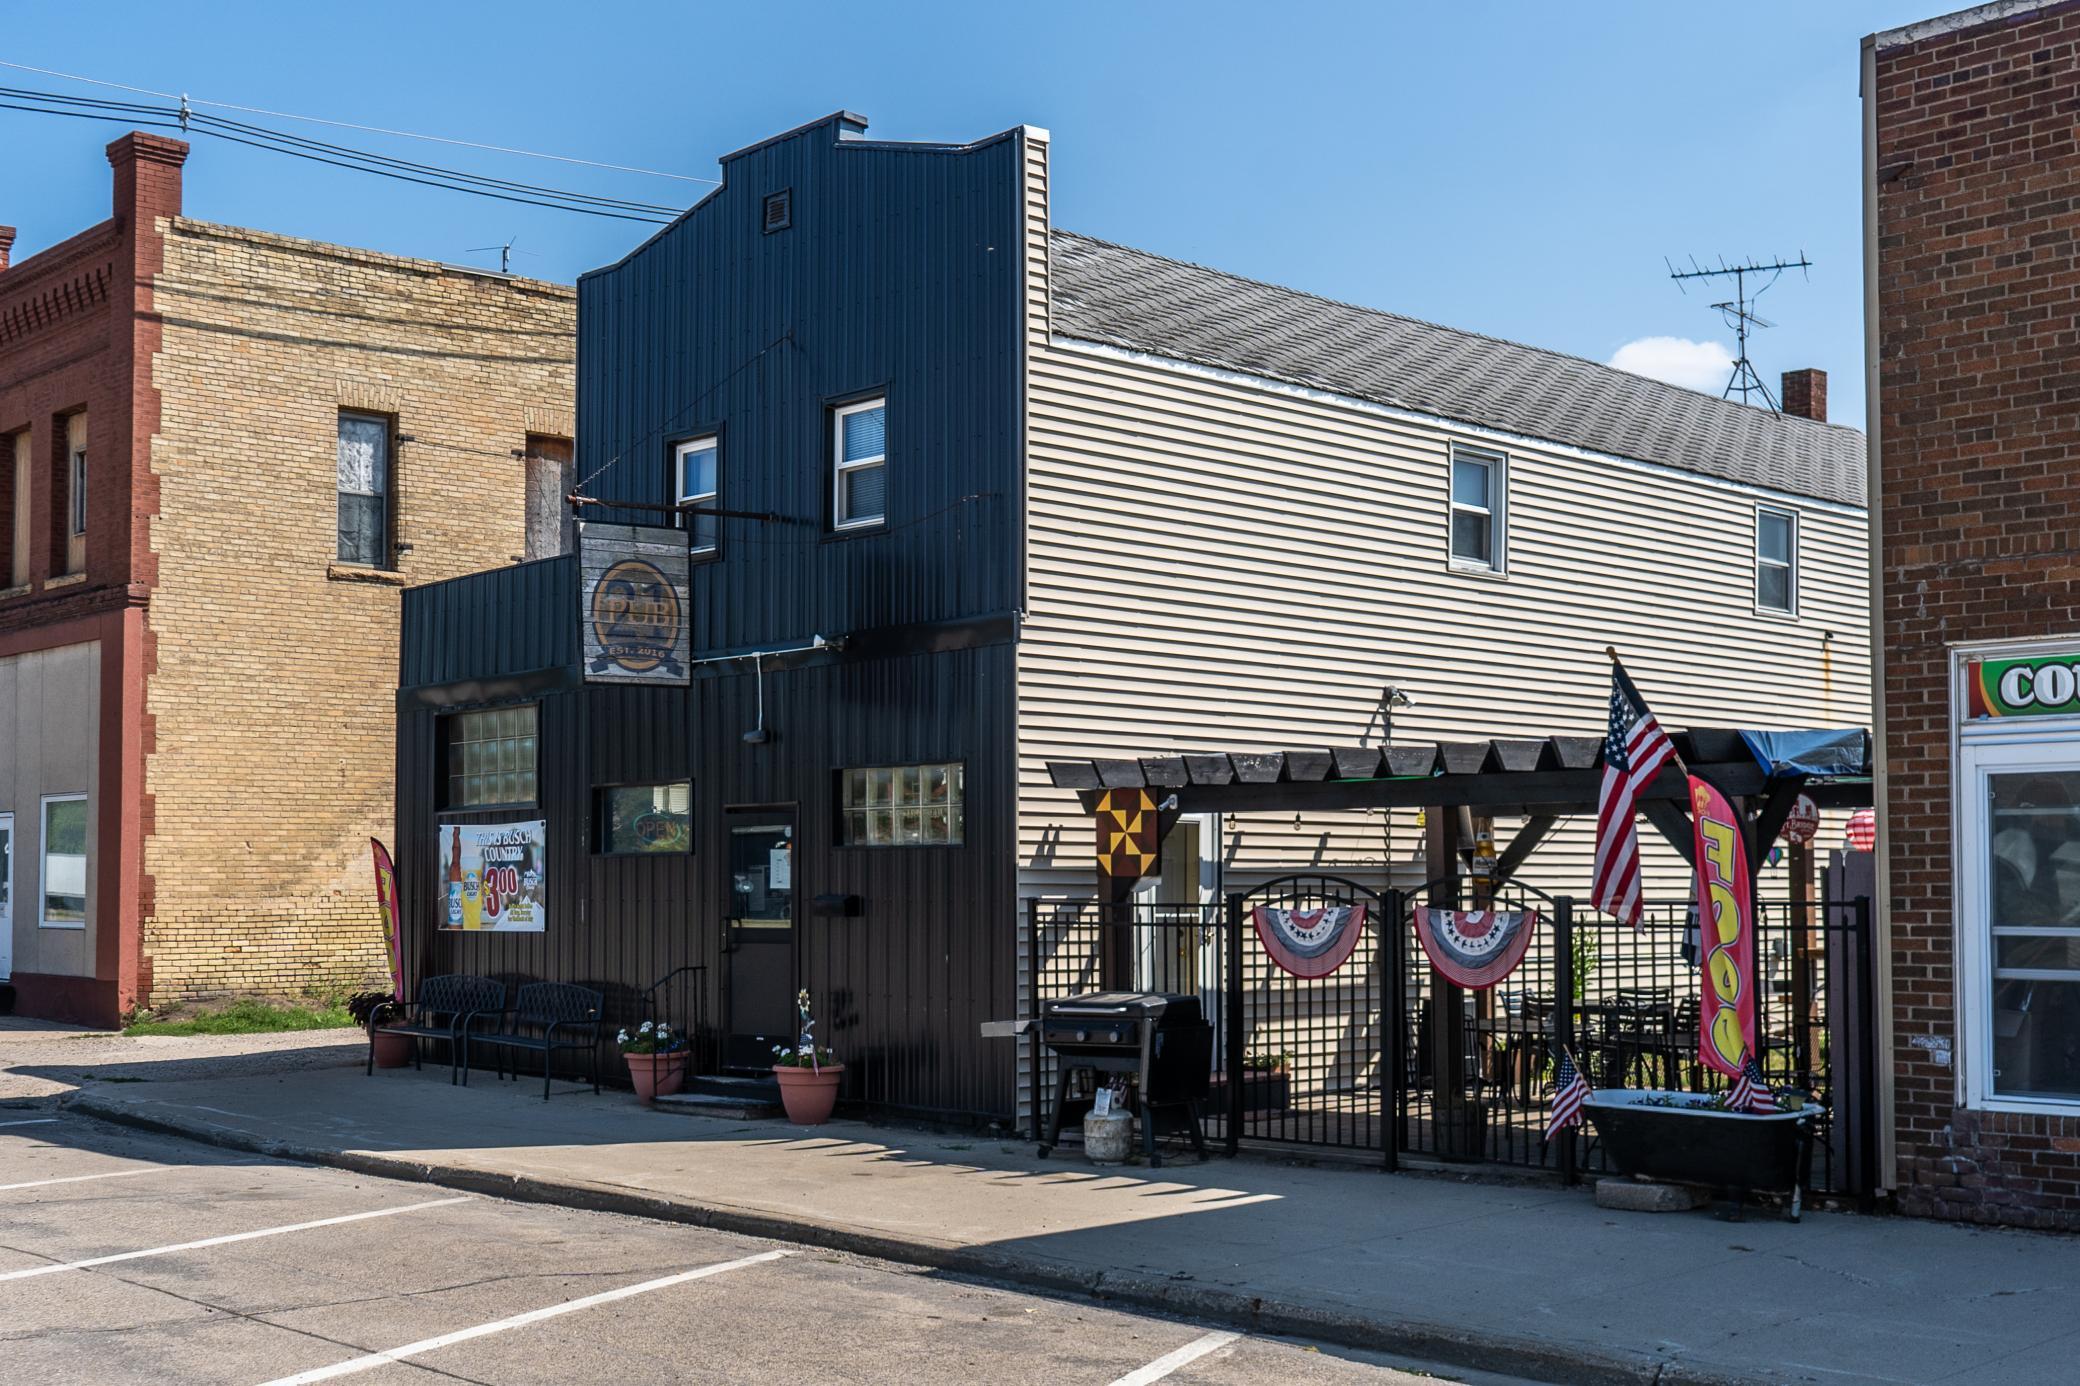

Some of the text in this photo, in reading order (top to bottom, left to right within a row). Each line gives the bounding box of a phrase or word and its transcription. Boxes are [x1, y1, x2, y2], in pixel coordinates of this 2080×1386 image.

[608, 599, 670, 626] PUB
[1999, 662, 2080, 709] CO
[503, 829, 532, 844] BUSCH
[637, 821, 676, 838] OPEN
